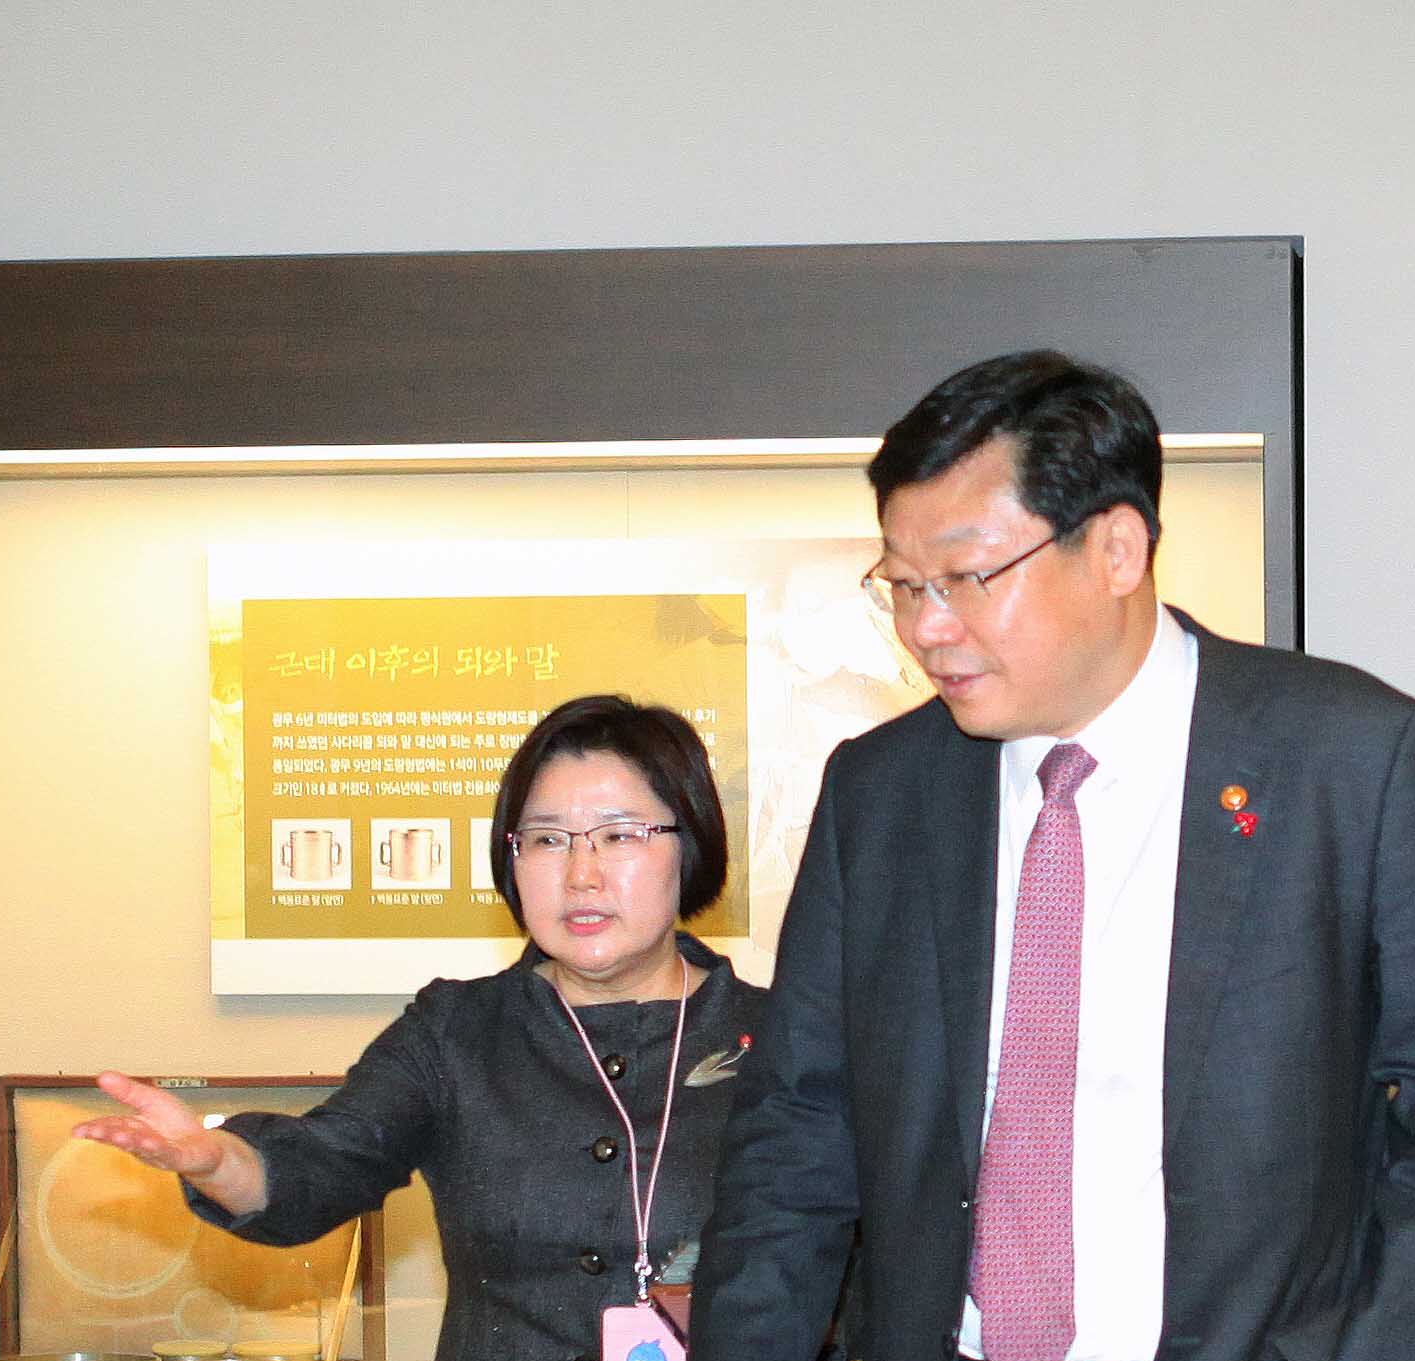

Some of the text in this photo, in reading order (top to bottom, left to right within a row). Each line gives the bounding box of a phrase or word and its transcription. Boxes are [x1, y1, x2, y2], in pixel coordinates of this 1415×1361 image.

[269, 644, 561, 682] 근대 이후의 되와 말
[295, 712, 314, 727] 6년
[361, 712, 393, 727] 도입에
[272, 736, 294, 750] 까지
